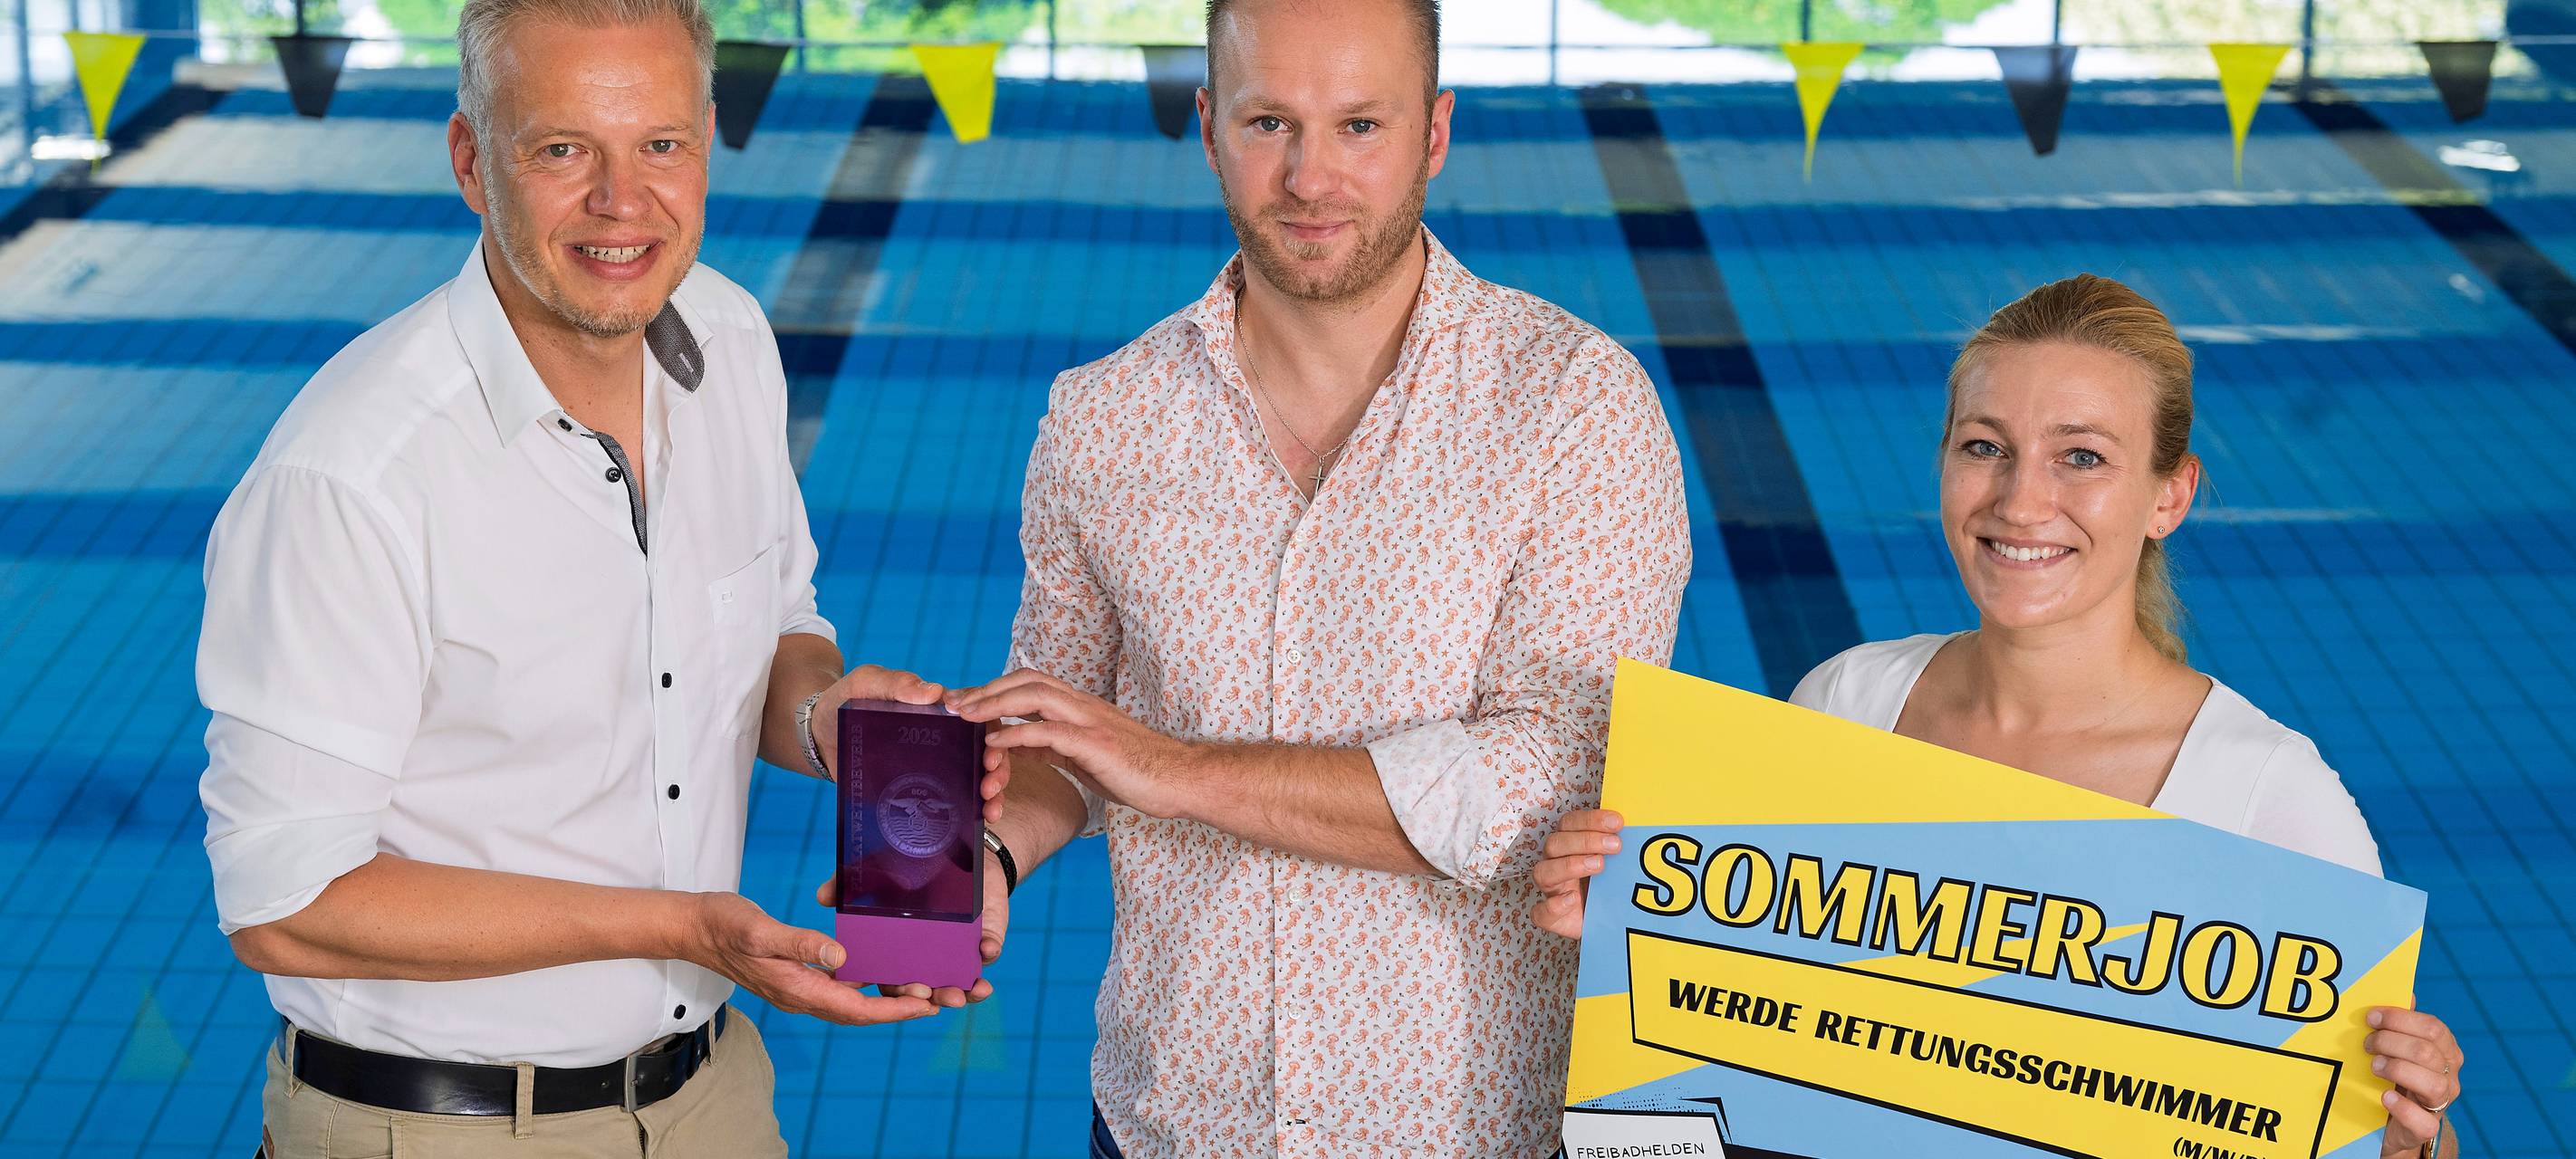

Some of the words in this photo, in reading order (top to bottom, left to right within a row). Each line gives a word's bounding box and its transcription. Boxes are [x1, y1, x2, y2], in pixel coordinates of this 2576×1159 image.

[897, 726, 942, 745] 2025
[1631, 833, 2342, 1022] SOMMERJOB
[1669, 979, 1802, 1033] WERDE
[1815, 1011, 2282, 1143] RETTUNGSSCHWIMMER
[1577, 1143, 1705, 1159] FREIBADHELDEN
[2173, 1136, 2266, 1159] (M/W
